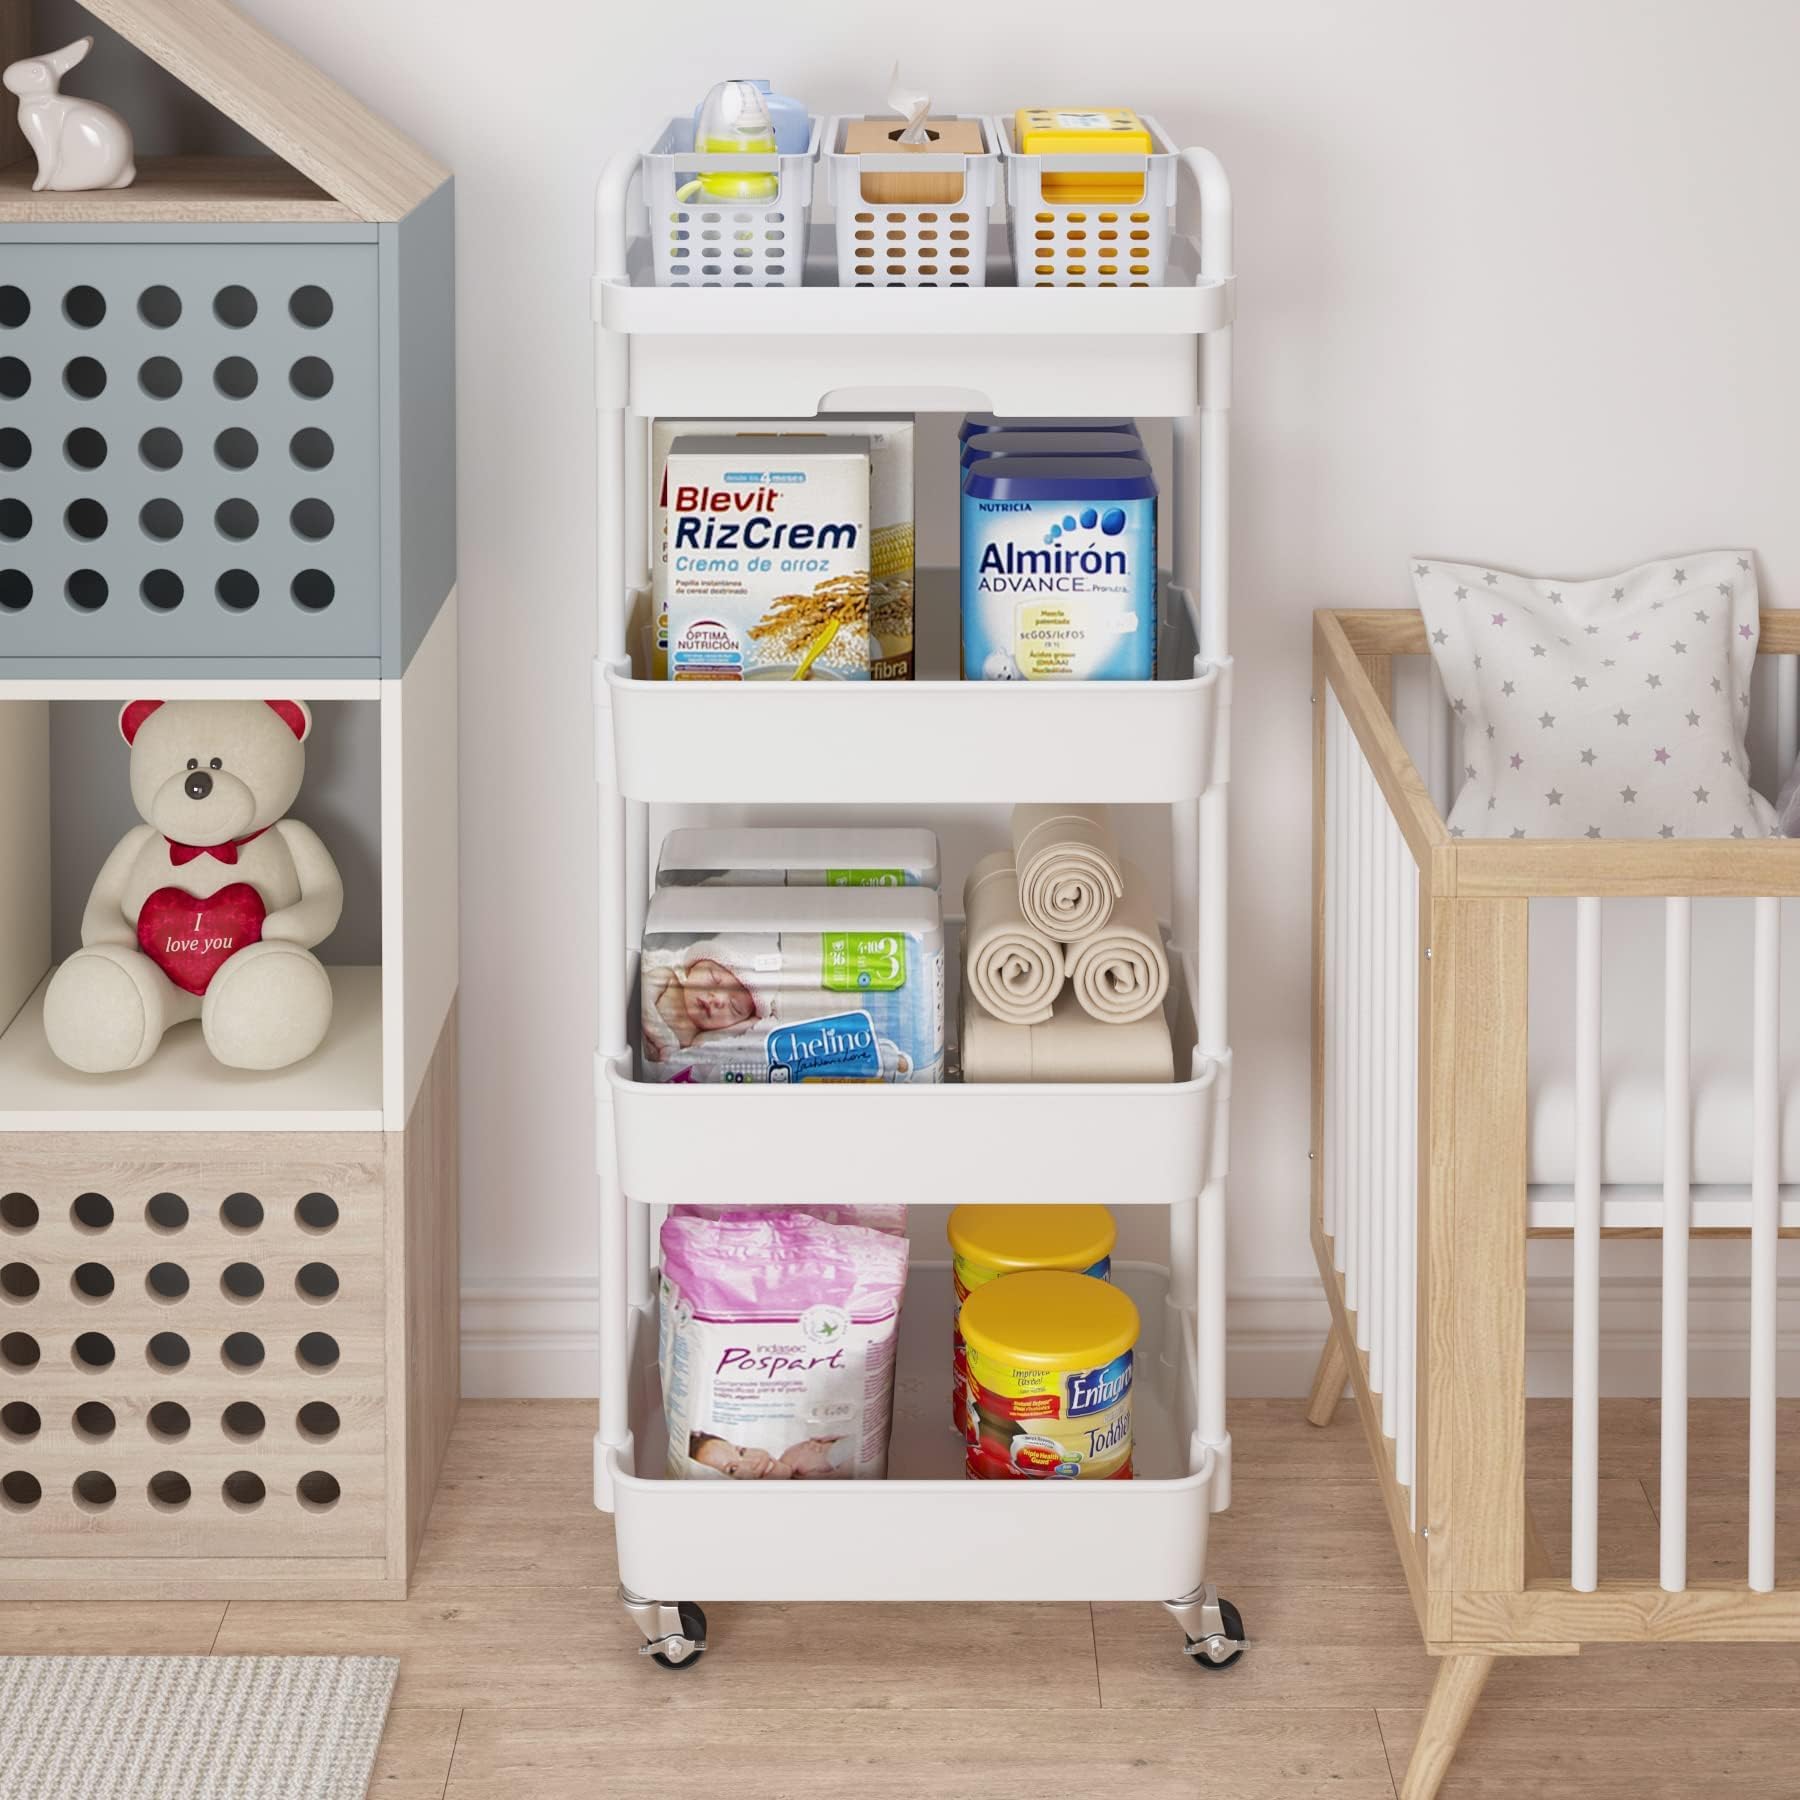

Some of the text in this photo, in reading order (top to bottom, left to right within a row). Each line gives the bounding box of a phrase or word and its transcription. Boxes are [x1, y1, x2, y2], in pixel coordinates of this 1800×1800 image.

[675, 487, 779, 512] Blevit
[978, 503, 1032, 512] NUTRICIA
[675, 517, 857, 549] RizCrem
[676, 556, 830, 572] Crema de arroz
[979, 541, 1126, 575] Almirón
[978, 577, 1086, 592] ADVANCE
[686, 628, 730, 640] ÓPTIMA
[678, 638, 740, 650] NUTRICIÓN
[874, 660, 907, 679] fibra
[194, 912, 203, 932] I
[165, 937, 233, 954] love you
[876, 937, 900, 979] 3
[771, 1027, 871, 1063] Chelino
[757, 1343, 806, 1354] indasec
[716, 1348, 843, 1379] Pospart
[1023, 1448, 1040, 1459] Triple
[1040, 1452, 1059, 1461] Health
[1031, 1456, 1050, 1466] Guard
